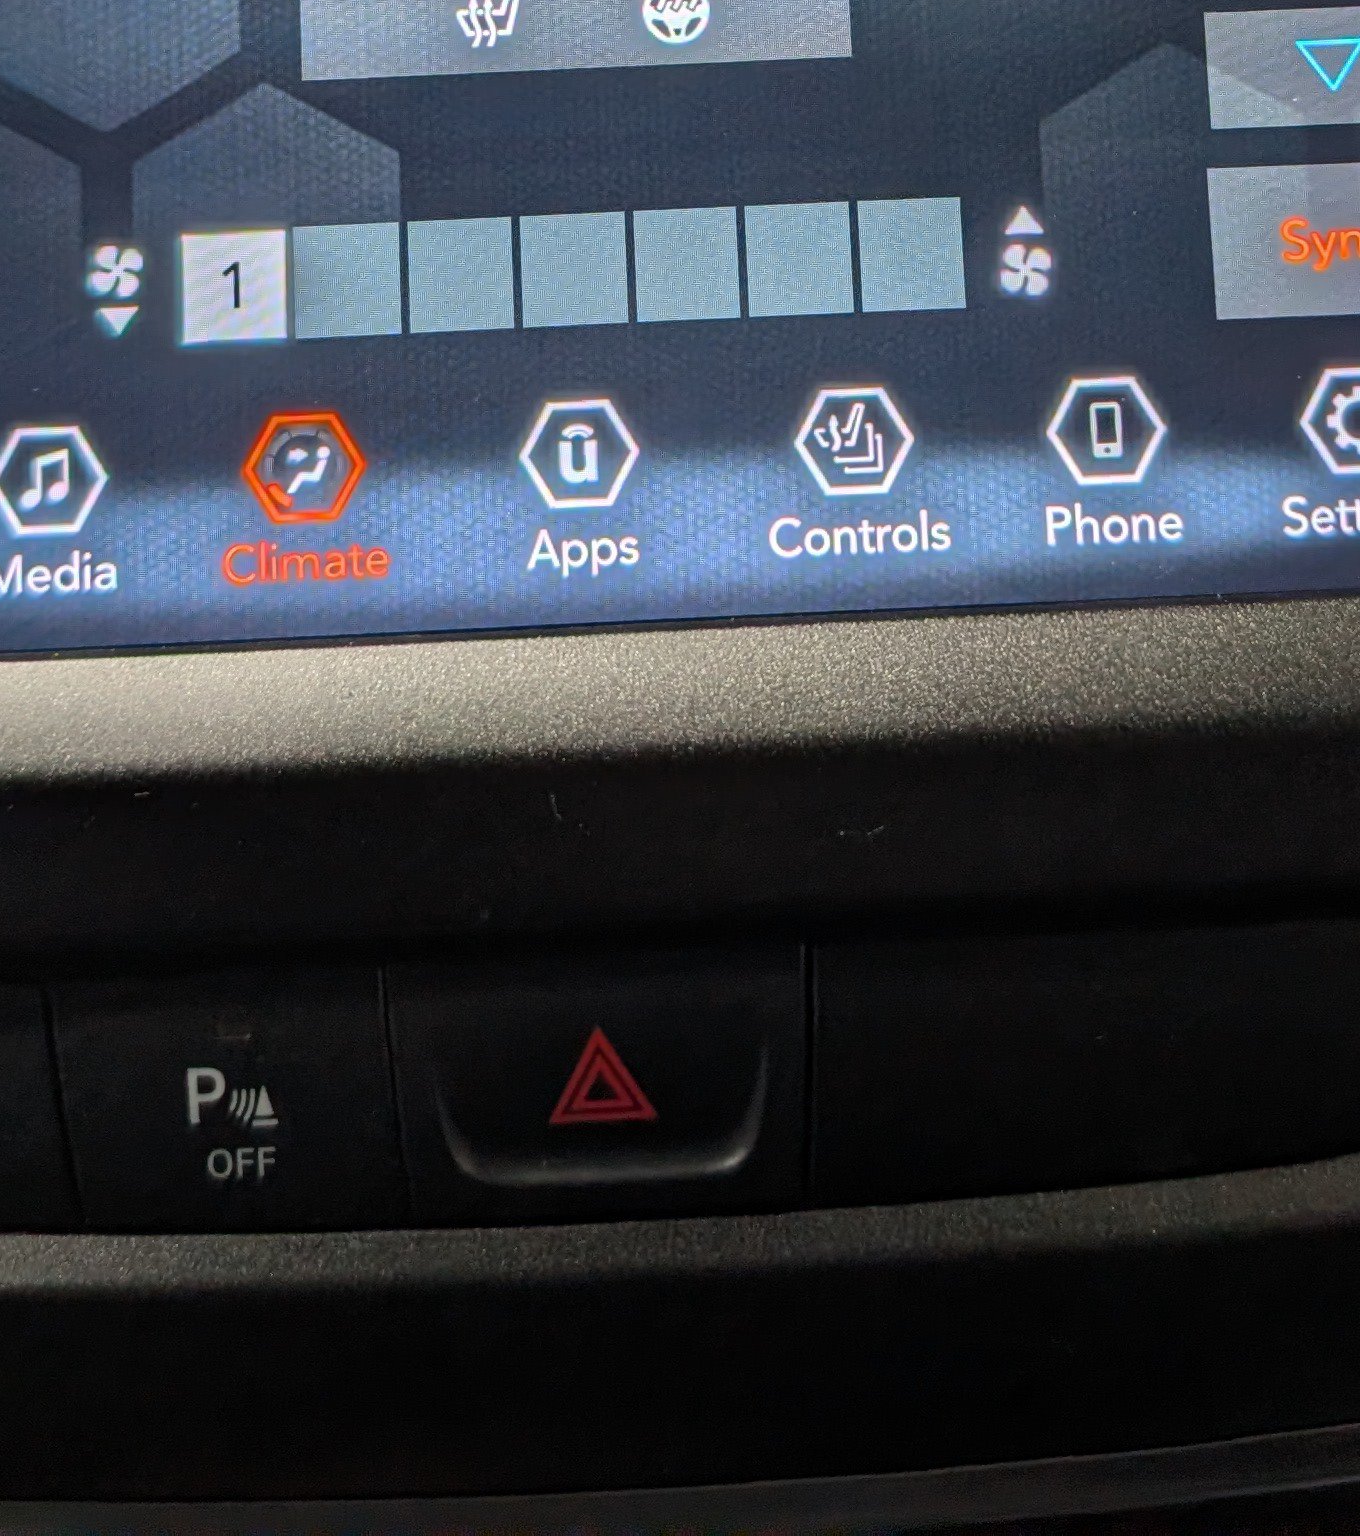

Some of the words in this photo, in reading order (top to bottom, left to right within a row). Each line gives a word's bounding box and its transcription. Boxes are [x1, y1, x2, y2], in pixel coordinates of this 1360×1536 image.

[222, 261, 241, 309] 1
[768, 508, 952, 558] Controls
[1046, 504, 1183, 544] Phone
[222, 542, 389, 585] Climate
[528, 529, 639, 577] Apps
[186, 1067, 225, 1125] P
[206, 1145, 275, 1180] OFF
